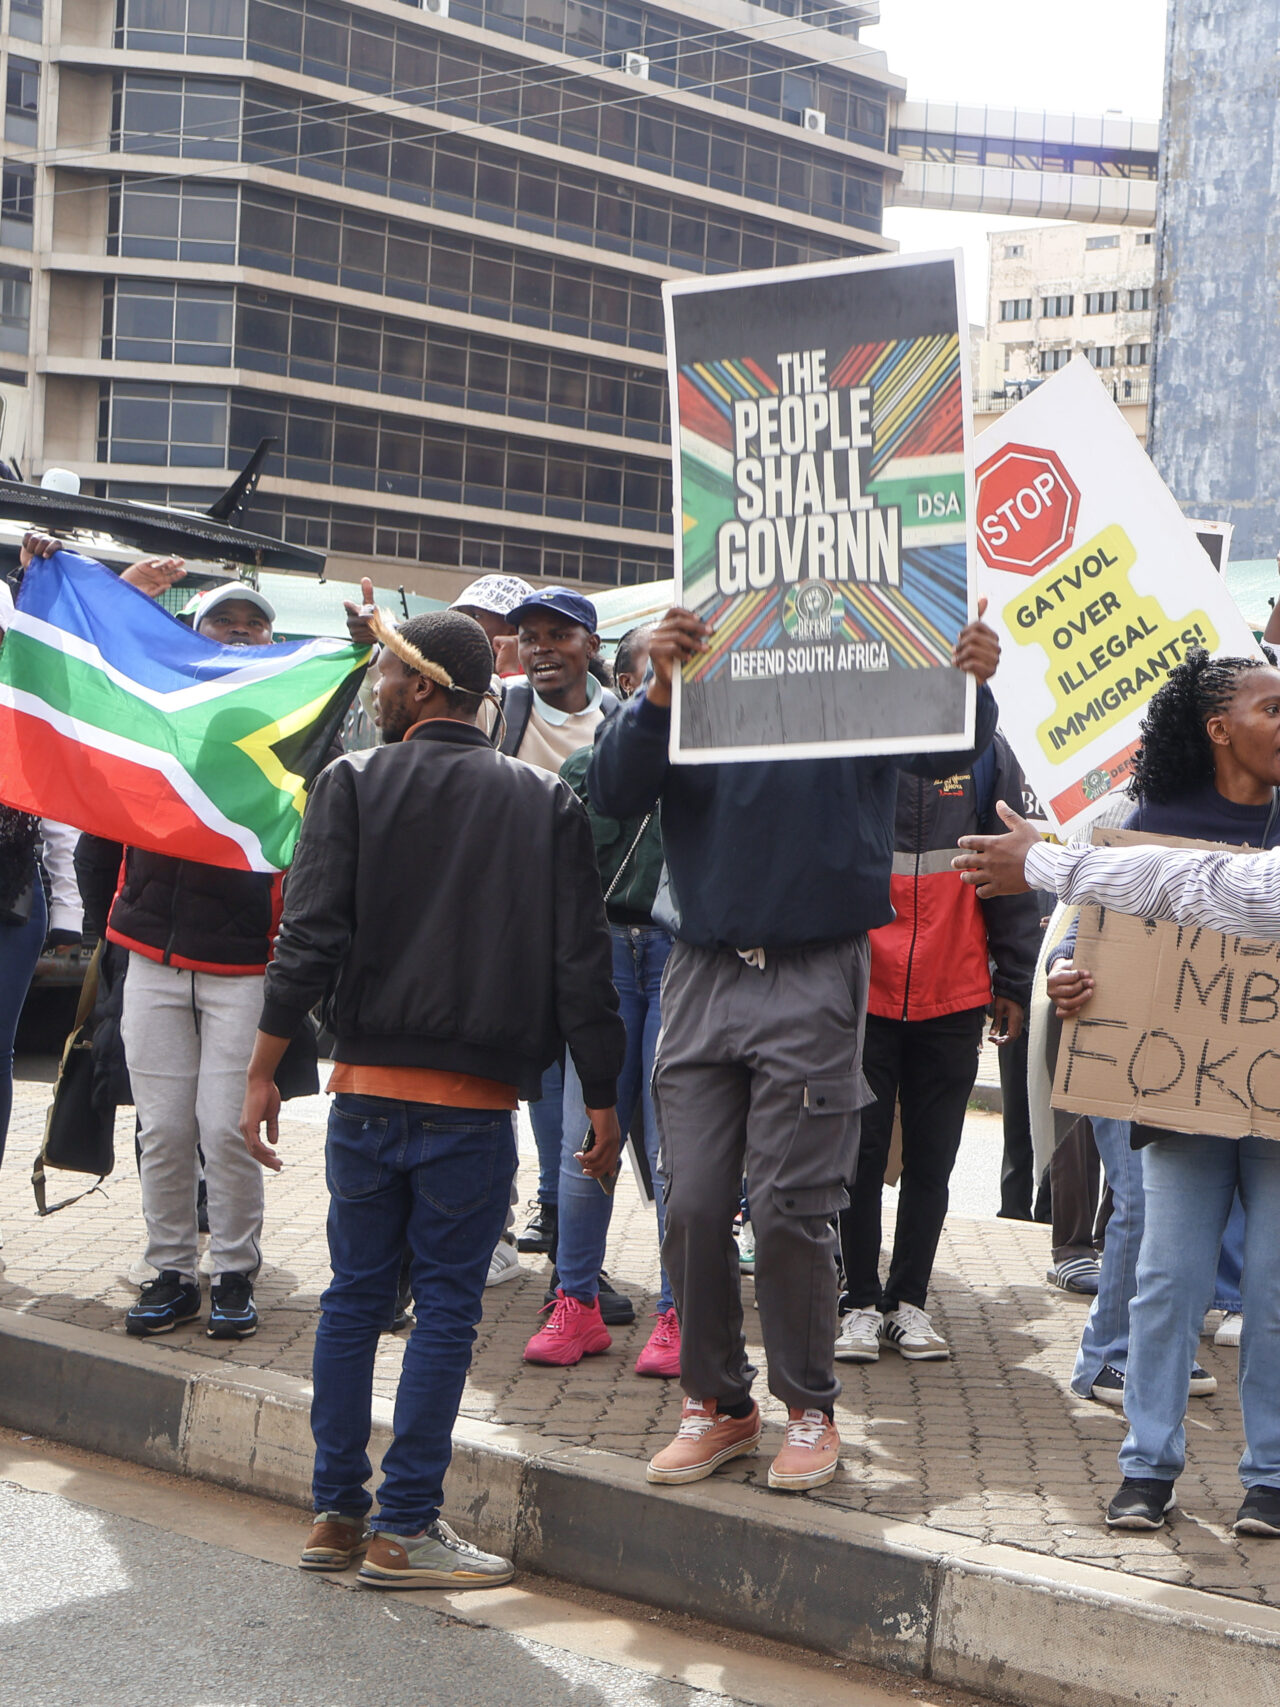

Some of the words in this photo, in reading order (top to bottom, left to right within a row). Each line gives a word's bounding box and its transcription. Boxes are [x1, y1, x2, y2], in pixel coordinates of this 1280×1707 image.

[777, 350, 827, 393] THE
[734, 387, 873, 459] PEOPLE
[736, 448, 873, 521] SHALL
[918, 491, 961, 519] DSA
[982, 472, 1056, 546] STOP
[717, 507, 901, 595] GOVRNN
[1016, 547, 1119, 628] GATVOL
[1053, 591, 1122, 650] OVER
[1057, 615, 1158, 696] ILLEGAL
[731, 650, 785, 679] DEFEND
[787, 646, 835, 675] SOUTH
[836, 641, 889, 671] AFRICA
[1047, 623, 1207, 750] IMMIGRANTS!
